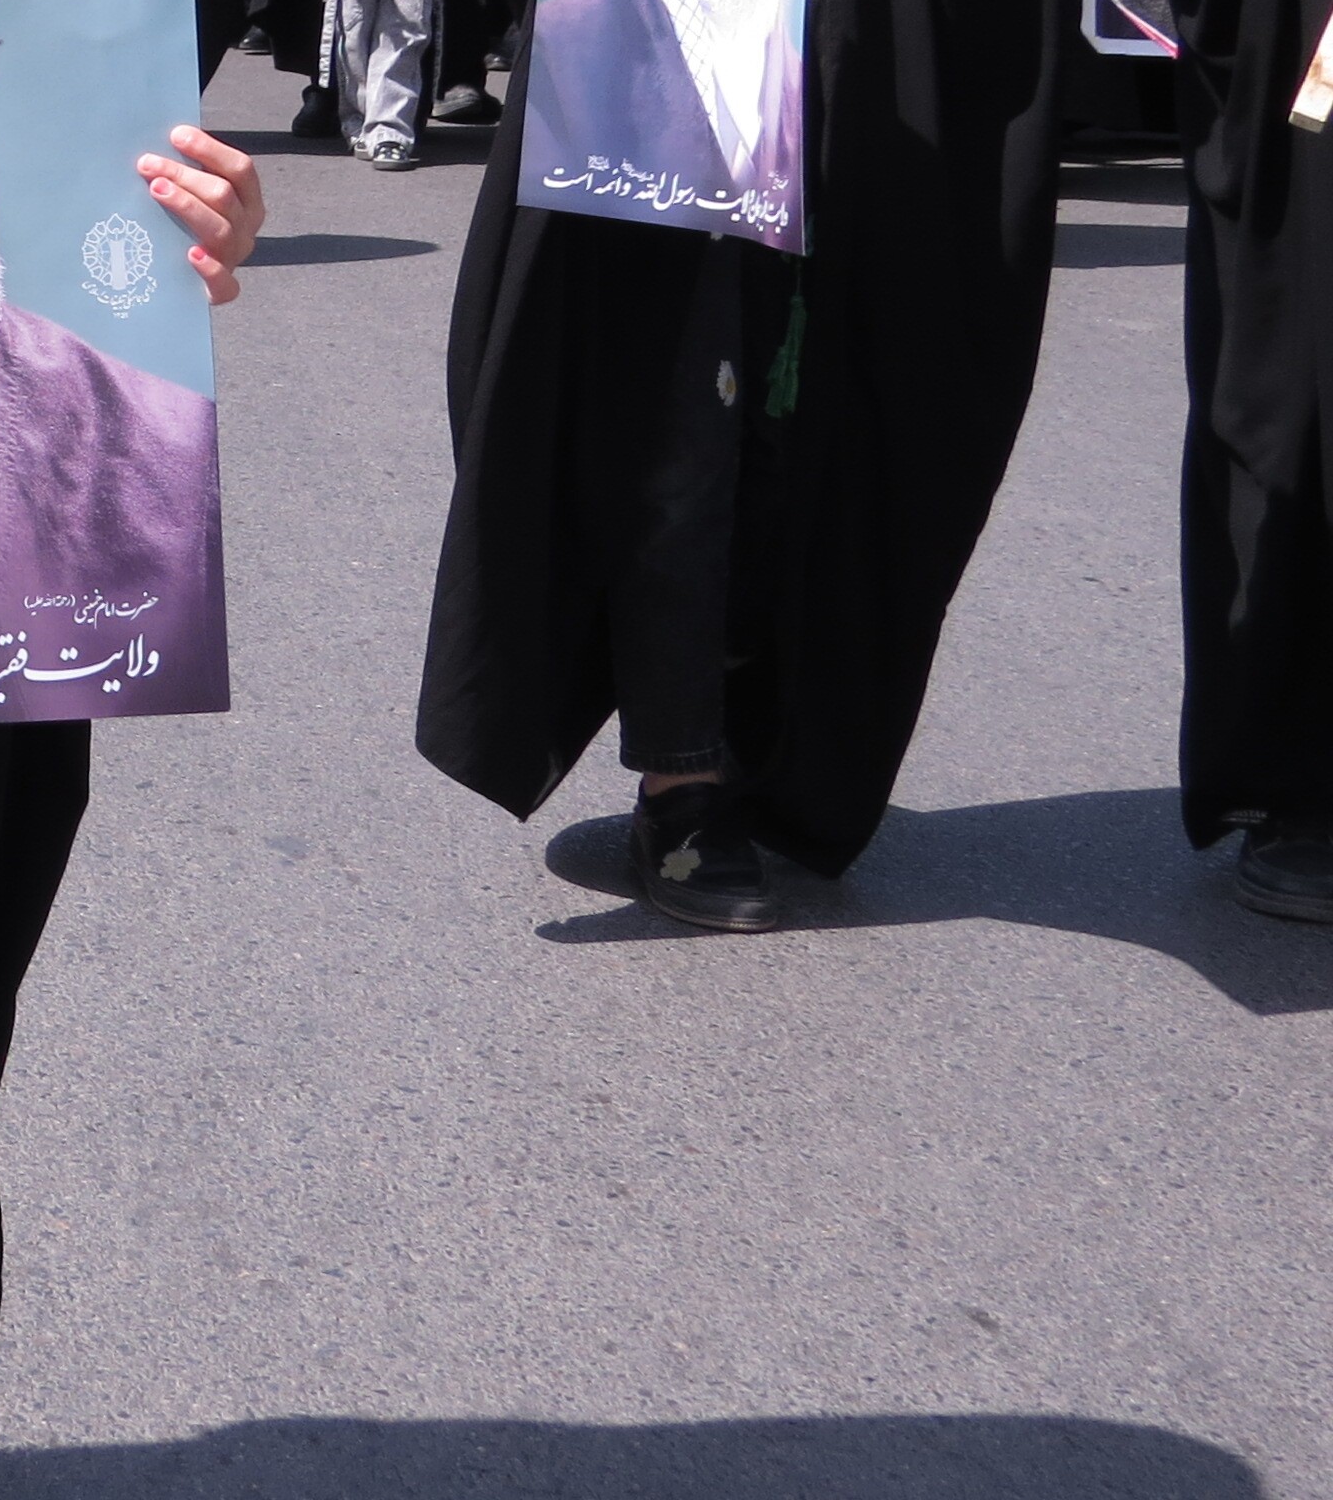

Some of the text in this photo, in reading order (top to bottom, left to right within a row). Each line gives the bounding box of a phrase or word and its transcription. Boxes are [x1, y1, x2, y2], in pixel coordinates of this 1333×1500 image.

[543, 167, 594, 191] است
[115, 591, 160, 621] حضرت
[22, 632, 160, 694] ولایت
